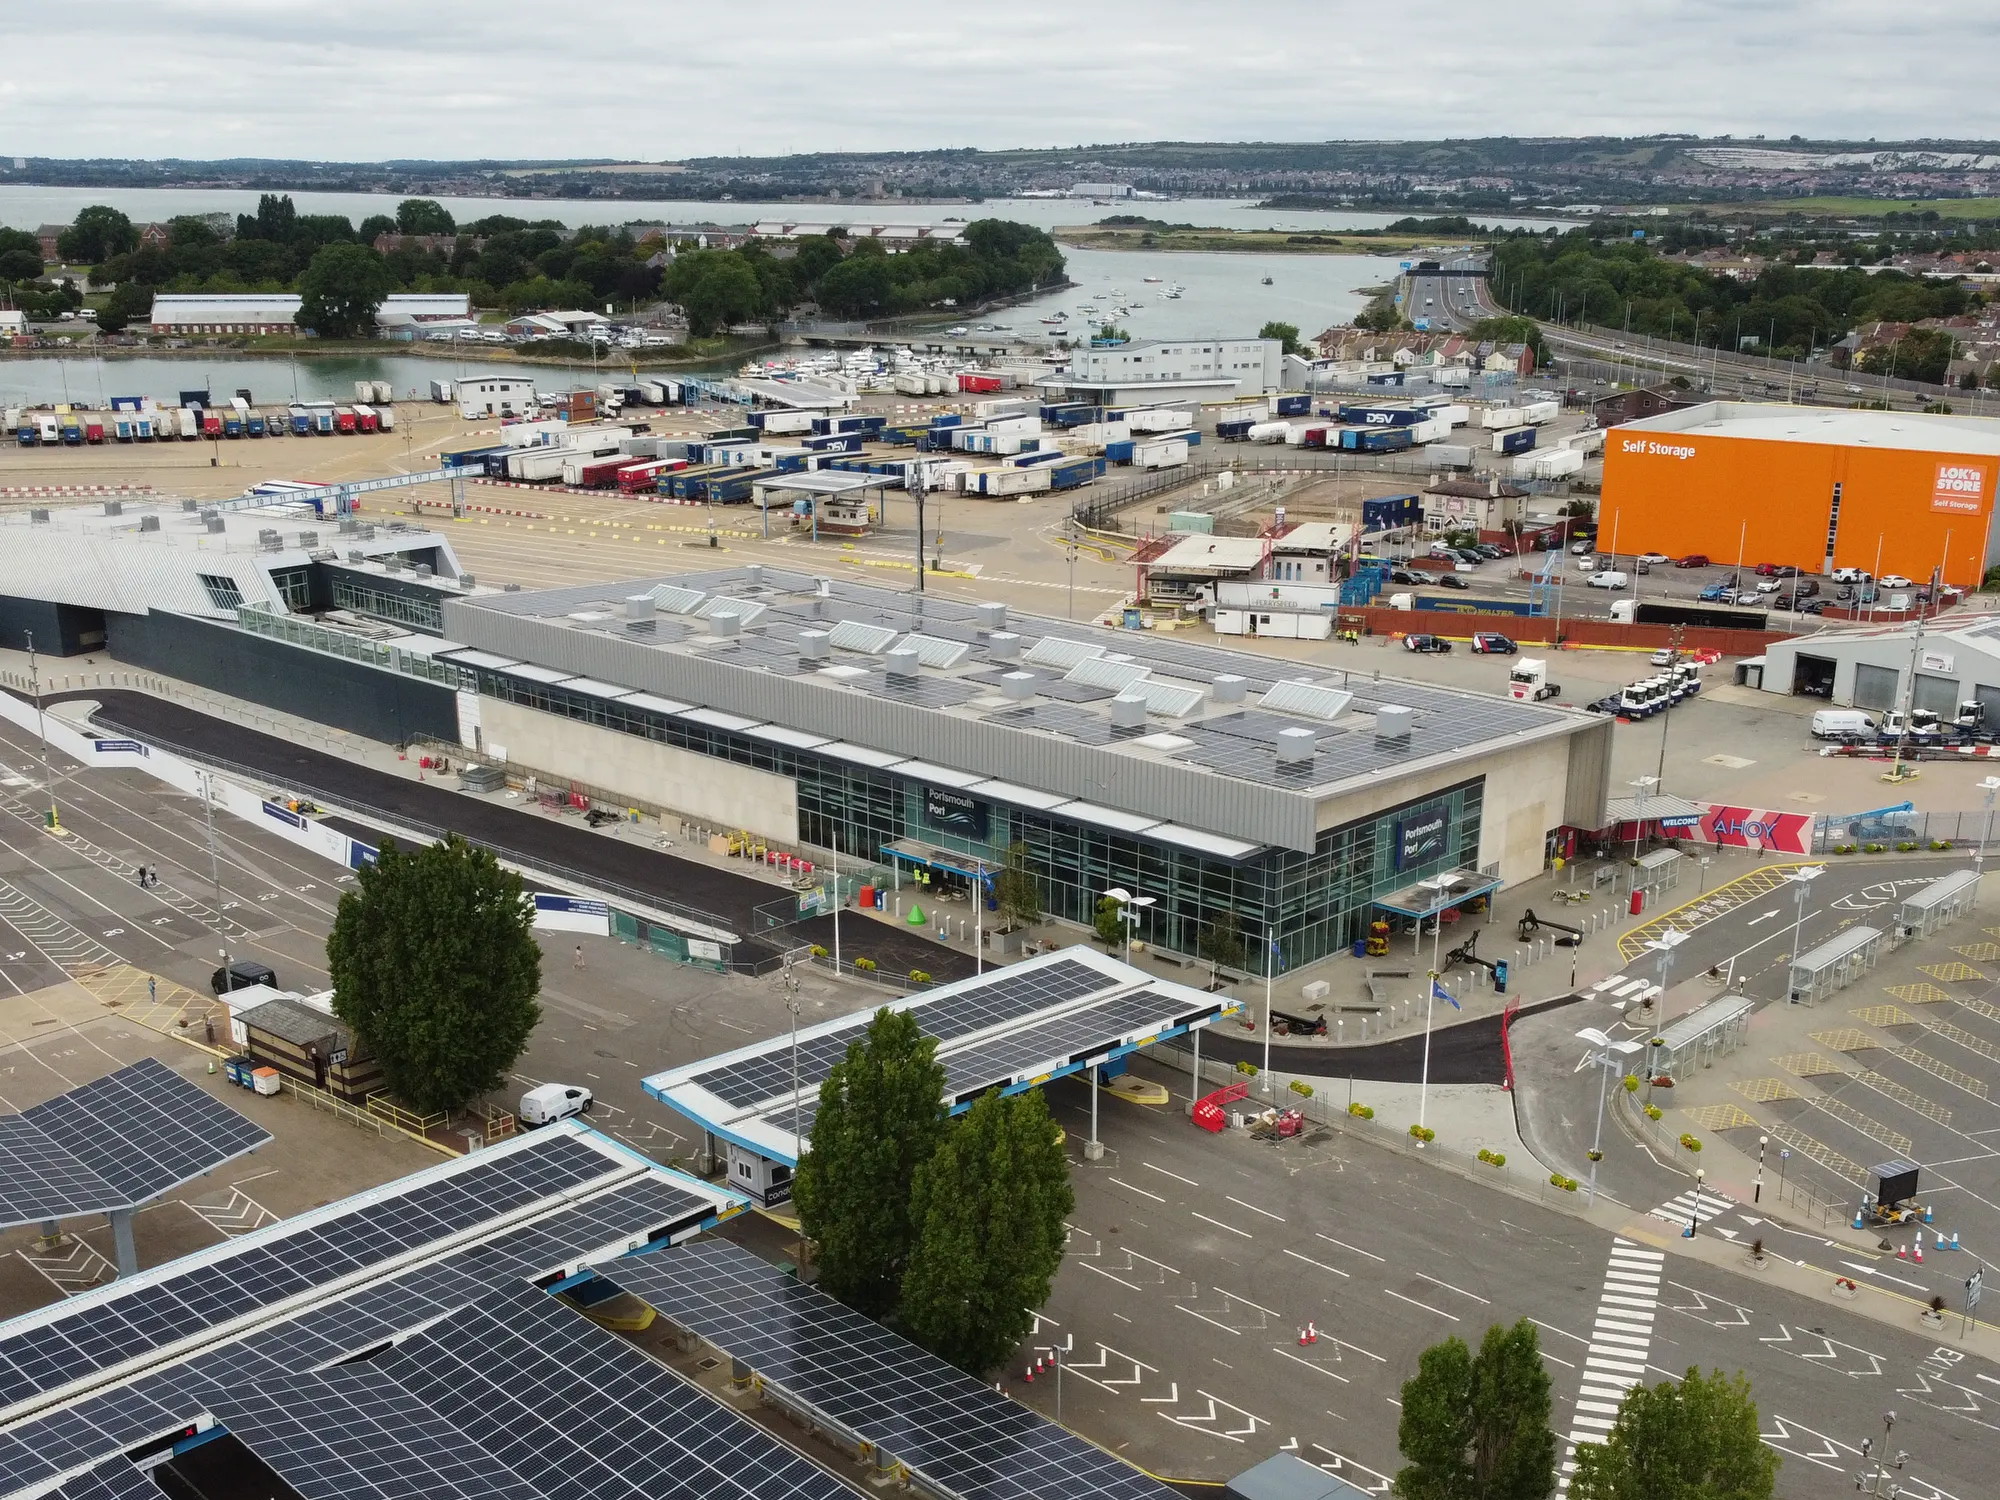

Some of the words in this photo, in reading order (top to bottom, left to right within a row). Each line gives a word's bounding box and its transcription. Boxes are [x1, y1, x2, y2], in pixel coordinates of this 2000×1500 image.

[1366, 413, 1395, 424] DSV
[826, 439, 848, 451] DSV
[1622, 440, 1646, 453] Self
[1648, 442, 1696, 459] Storage
[1937, 478, 1981, 492] STORE
[1949, 500, 1978, 511] Storage
[929, 788, 975, 809] Portsmouth
[929, 803, 946, 816] Port
[1662, 817, 1698, 827] WELCOME
[1405, 818, 1443, 840] Portsmouth
[1713, 819, 1777, 839] AHOY
[1404, 841, 1418, 856] Port
[296, 883, 316, 892] 24
[222, 901, 241, 910] 22
[151, 917, 173, 926] 21
[103, 928, 124, 938] 20
[1917, 1347, 1965, 1378] EXIT
